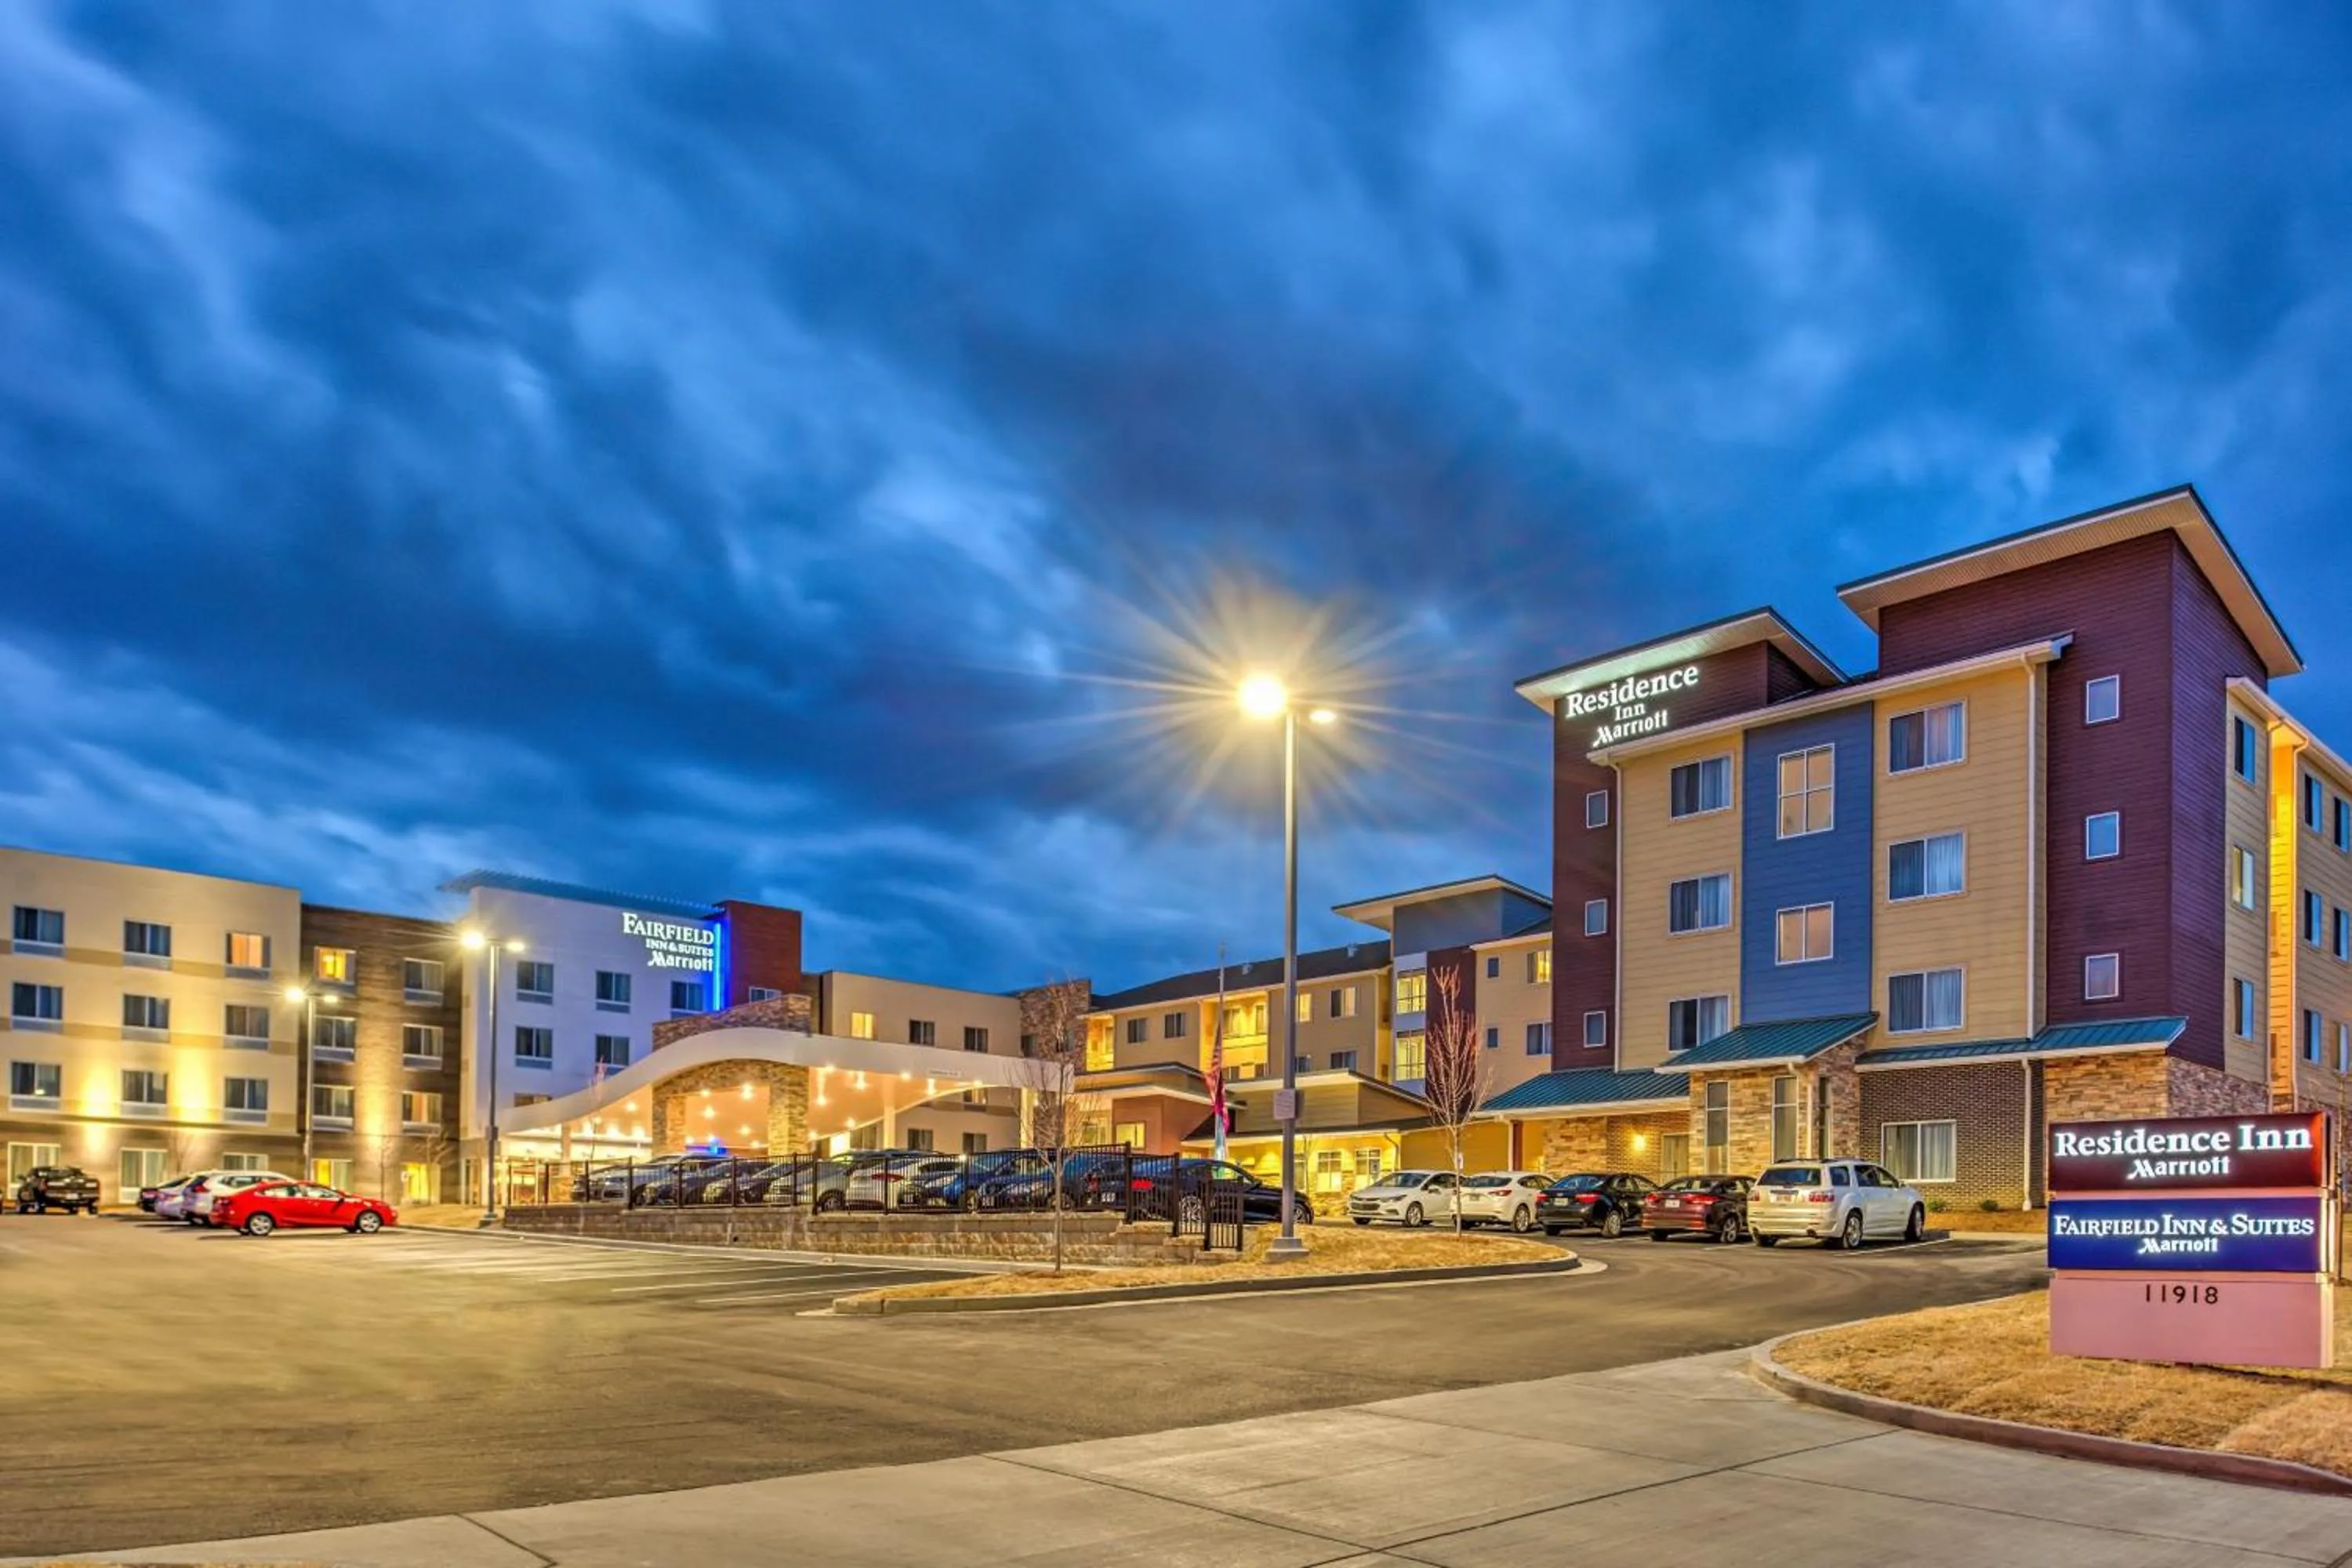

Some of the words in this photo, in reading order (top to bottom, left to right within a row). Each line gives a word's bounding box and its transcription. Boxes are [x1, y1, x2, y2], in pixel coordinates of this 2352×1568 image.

[1566, 666, 1698, 717] Residence
[1615, 703, 1645, 720] Inn
[1593, 710, 1668, 746] Marriott
[622, 913, 713, 945] FAIRFIELD
[646, 938, 666, 950] INN
[667, 942, 678, 953] &
[679, 945, 714, 957] SUITES
[648, 950, 713, 971] Marriott
[2055, 1129, 2230, 1156] Residence
[2238, 1124, 2312, 1150] Inn
[2127, 1156, 2230, 1179] Marriott
[2054, 1215, 2159, 1236] FAIRFIELD
[2162, 1214, 2207, 1235] INN
[2209, 1219, 2227, 1235] &
[2231, 1214, 2315, 1236] SUITES
[2138, 1238, 2218, 1254] Marriott
[2146, 1284, 2219, 1305] 11918
